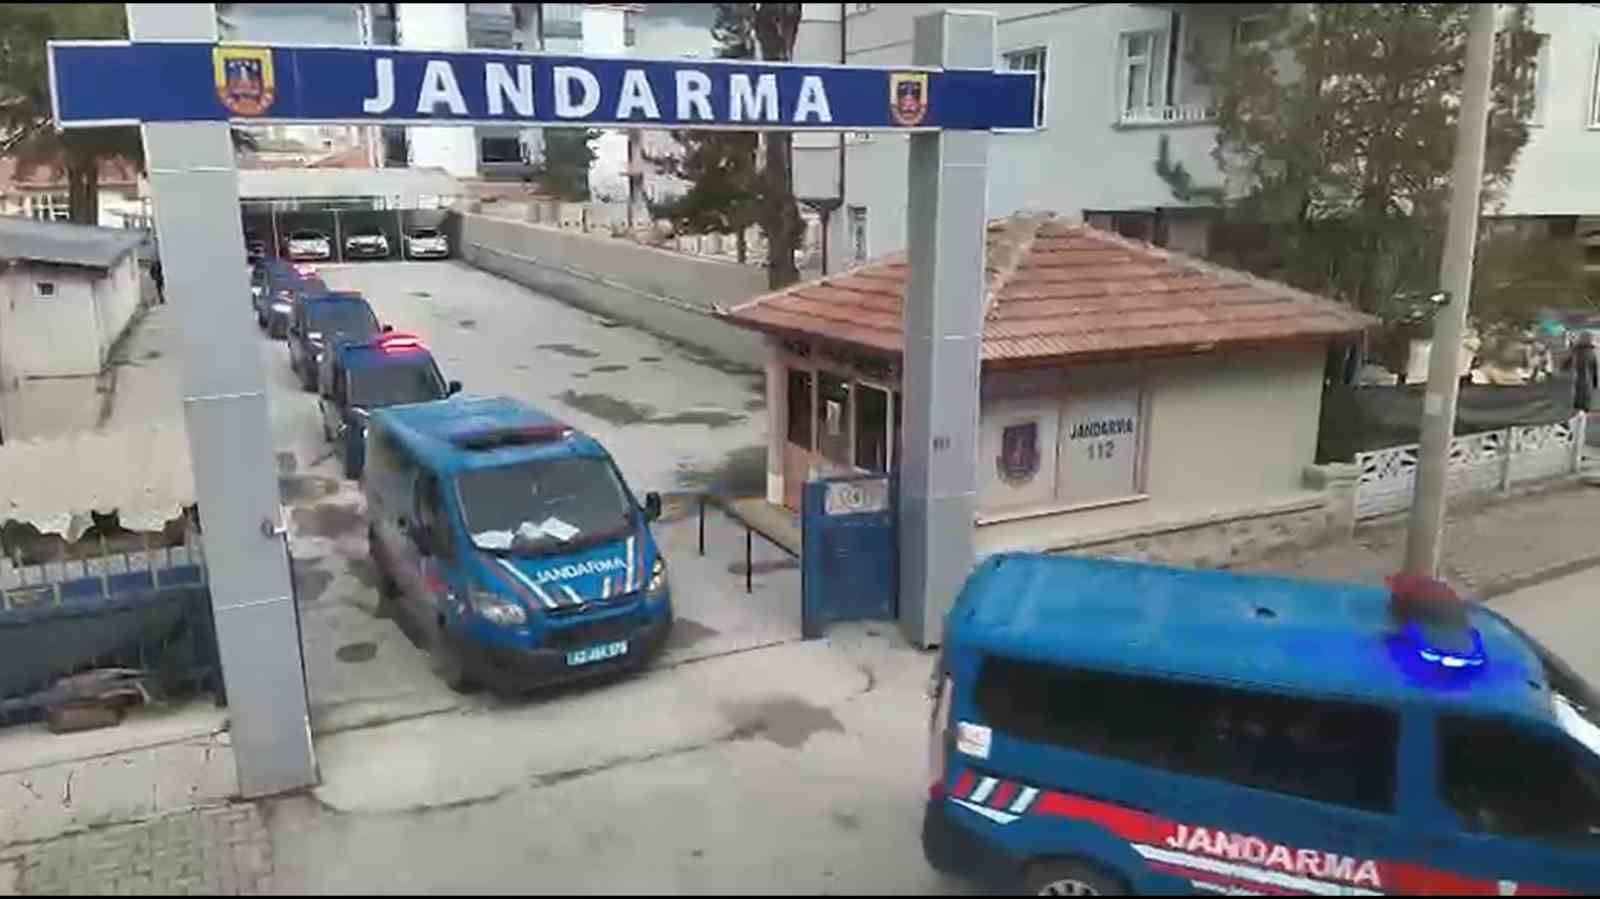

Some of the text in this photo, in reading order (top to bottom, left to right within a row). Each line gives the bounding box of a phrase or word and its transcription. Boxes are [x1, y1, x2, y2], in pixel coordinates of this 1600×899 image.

[363, 58, 833, 123] JANDARMA
[1070, 418, 1133, 440] JANDARMA
[1087, 440, 1115, 460] 112
[535, 557, 627, 584] JANDARMA
[1166, 824, 1382, 886] JANDARMA
